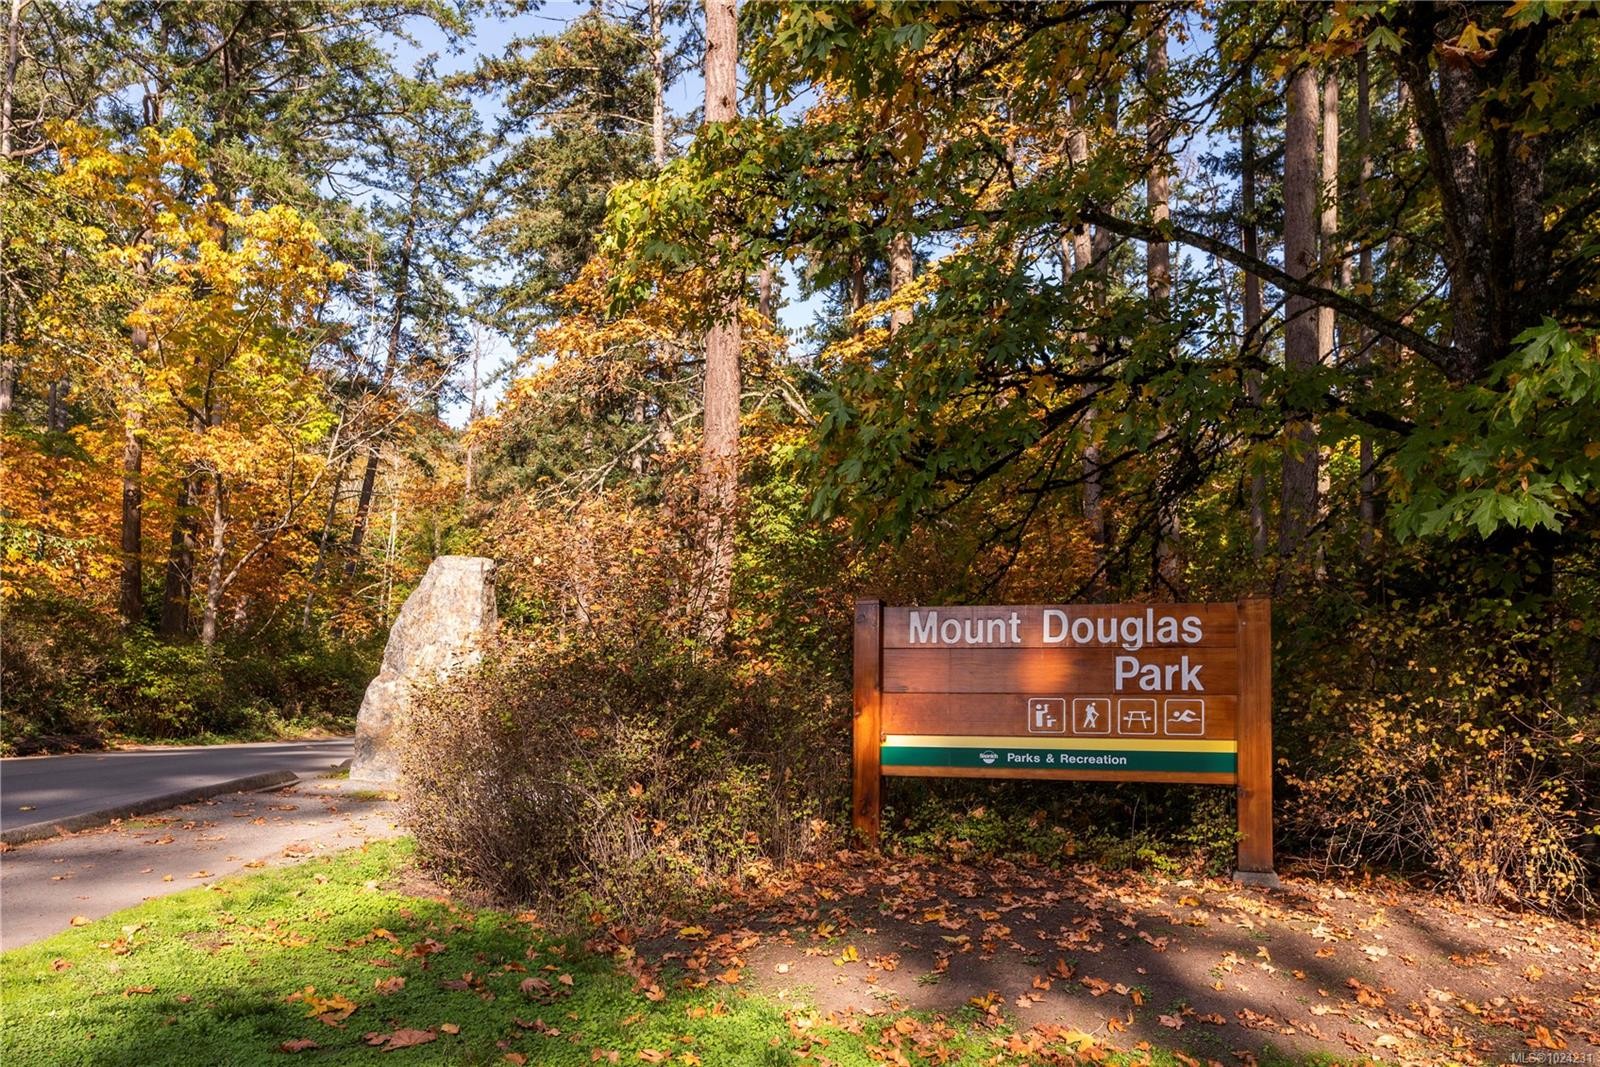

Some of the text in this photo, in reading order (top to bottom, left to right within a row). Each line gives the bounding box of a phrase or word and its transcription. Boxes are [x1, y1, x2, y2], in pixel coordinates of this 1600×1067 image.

[908, 608, 1203, 651] Mount Douglas
[1114, 655, 1204, 692] Park
[1007, 752, 1127, 765] Parks & Recreation
